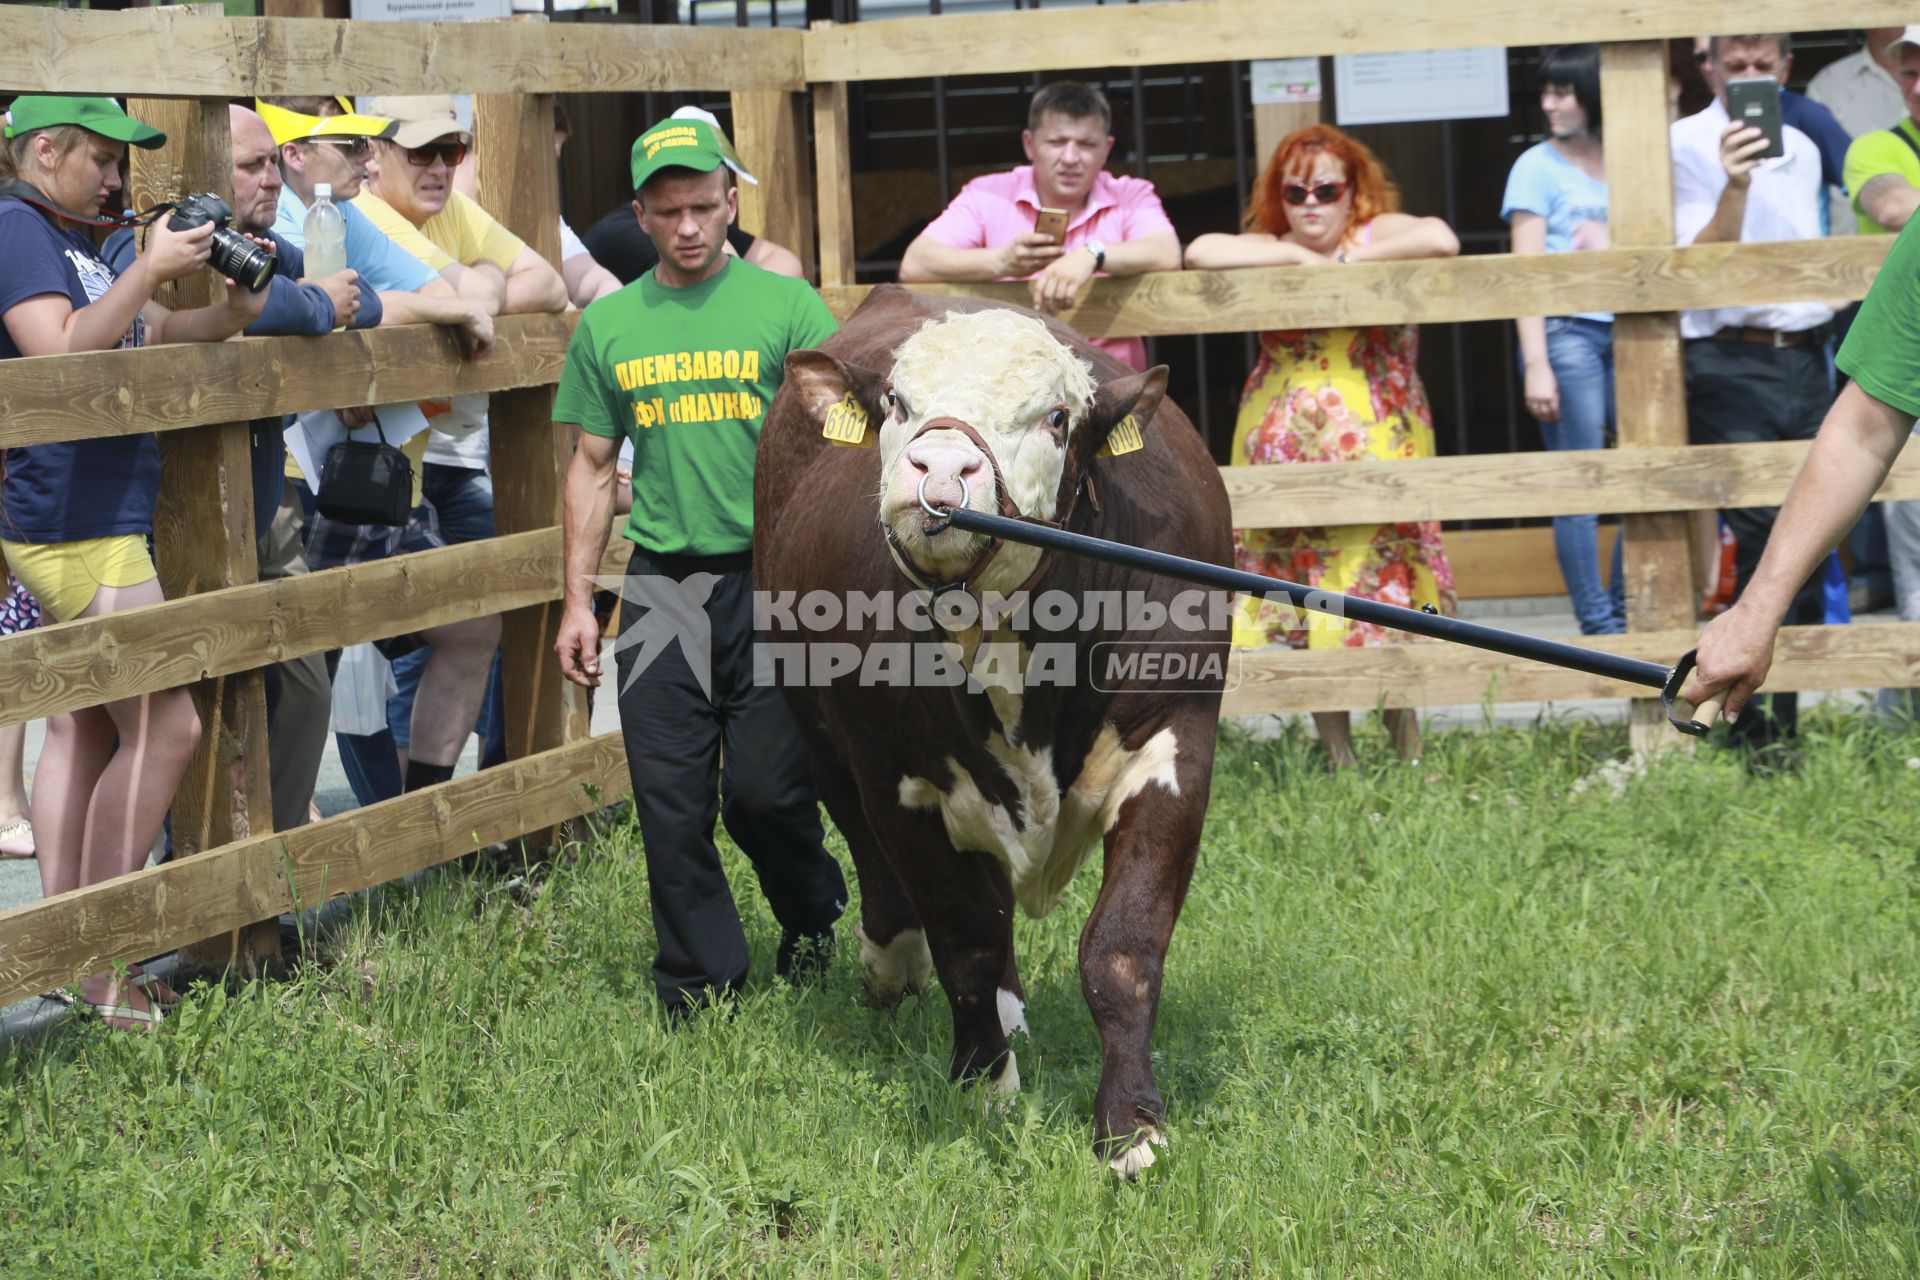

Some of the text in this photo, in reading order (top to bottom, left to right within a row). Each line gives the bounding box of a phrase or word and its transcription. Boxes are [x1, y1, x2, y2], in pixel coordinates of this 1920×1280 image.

[615, 349, 760, 391] ПЛЕМЗАВОД
[669, 392, 762, 424] «НАУКА»
[826, 407, 868, 442] 6101
